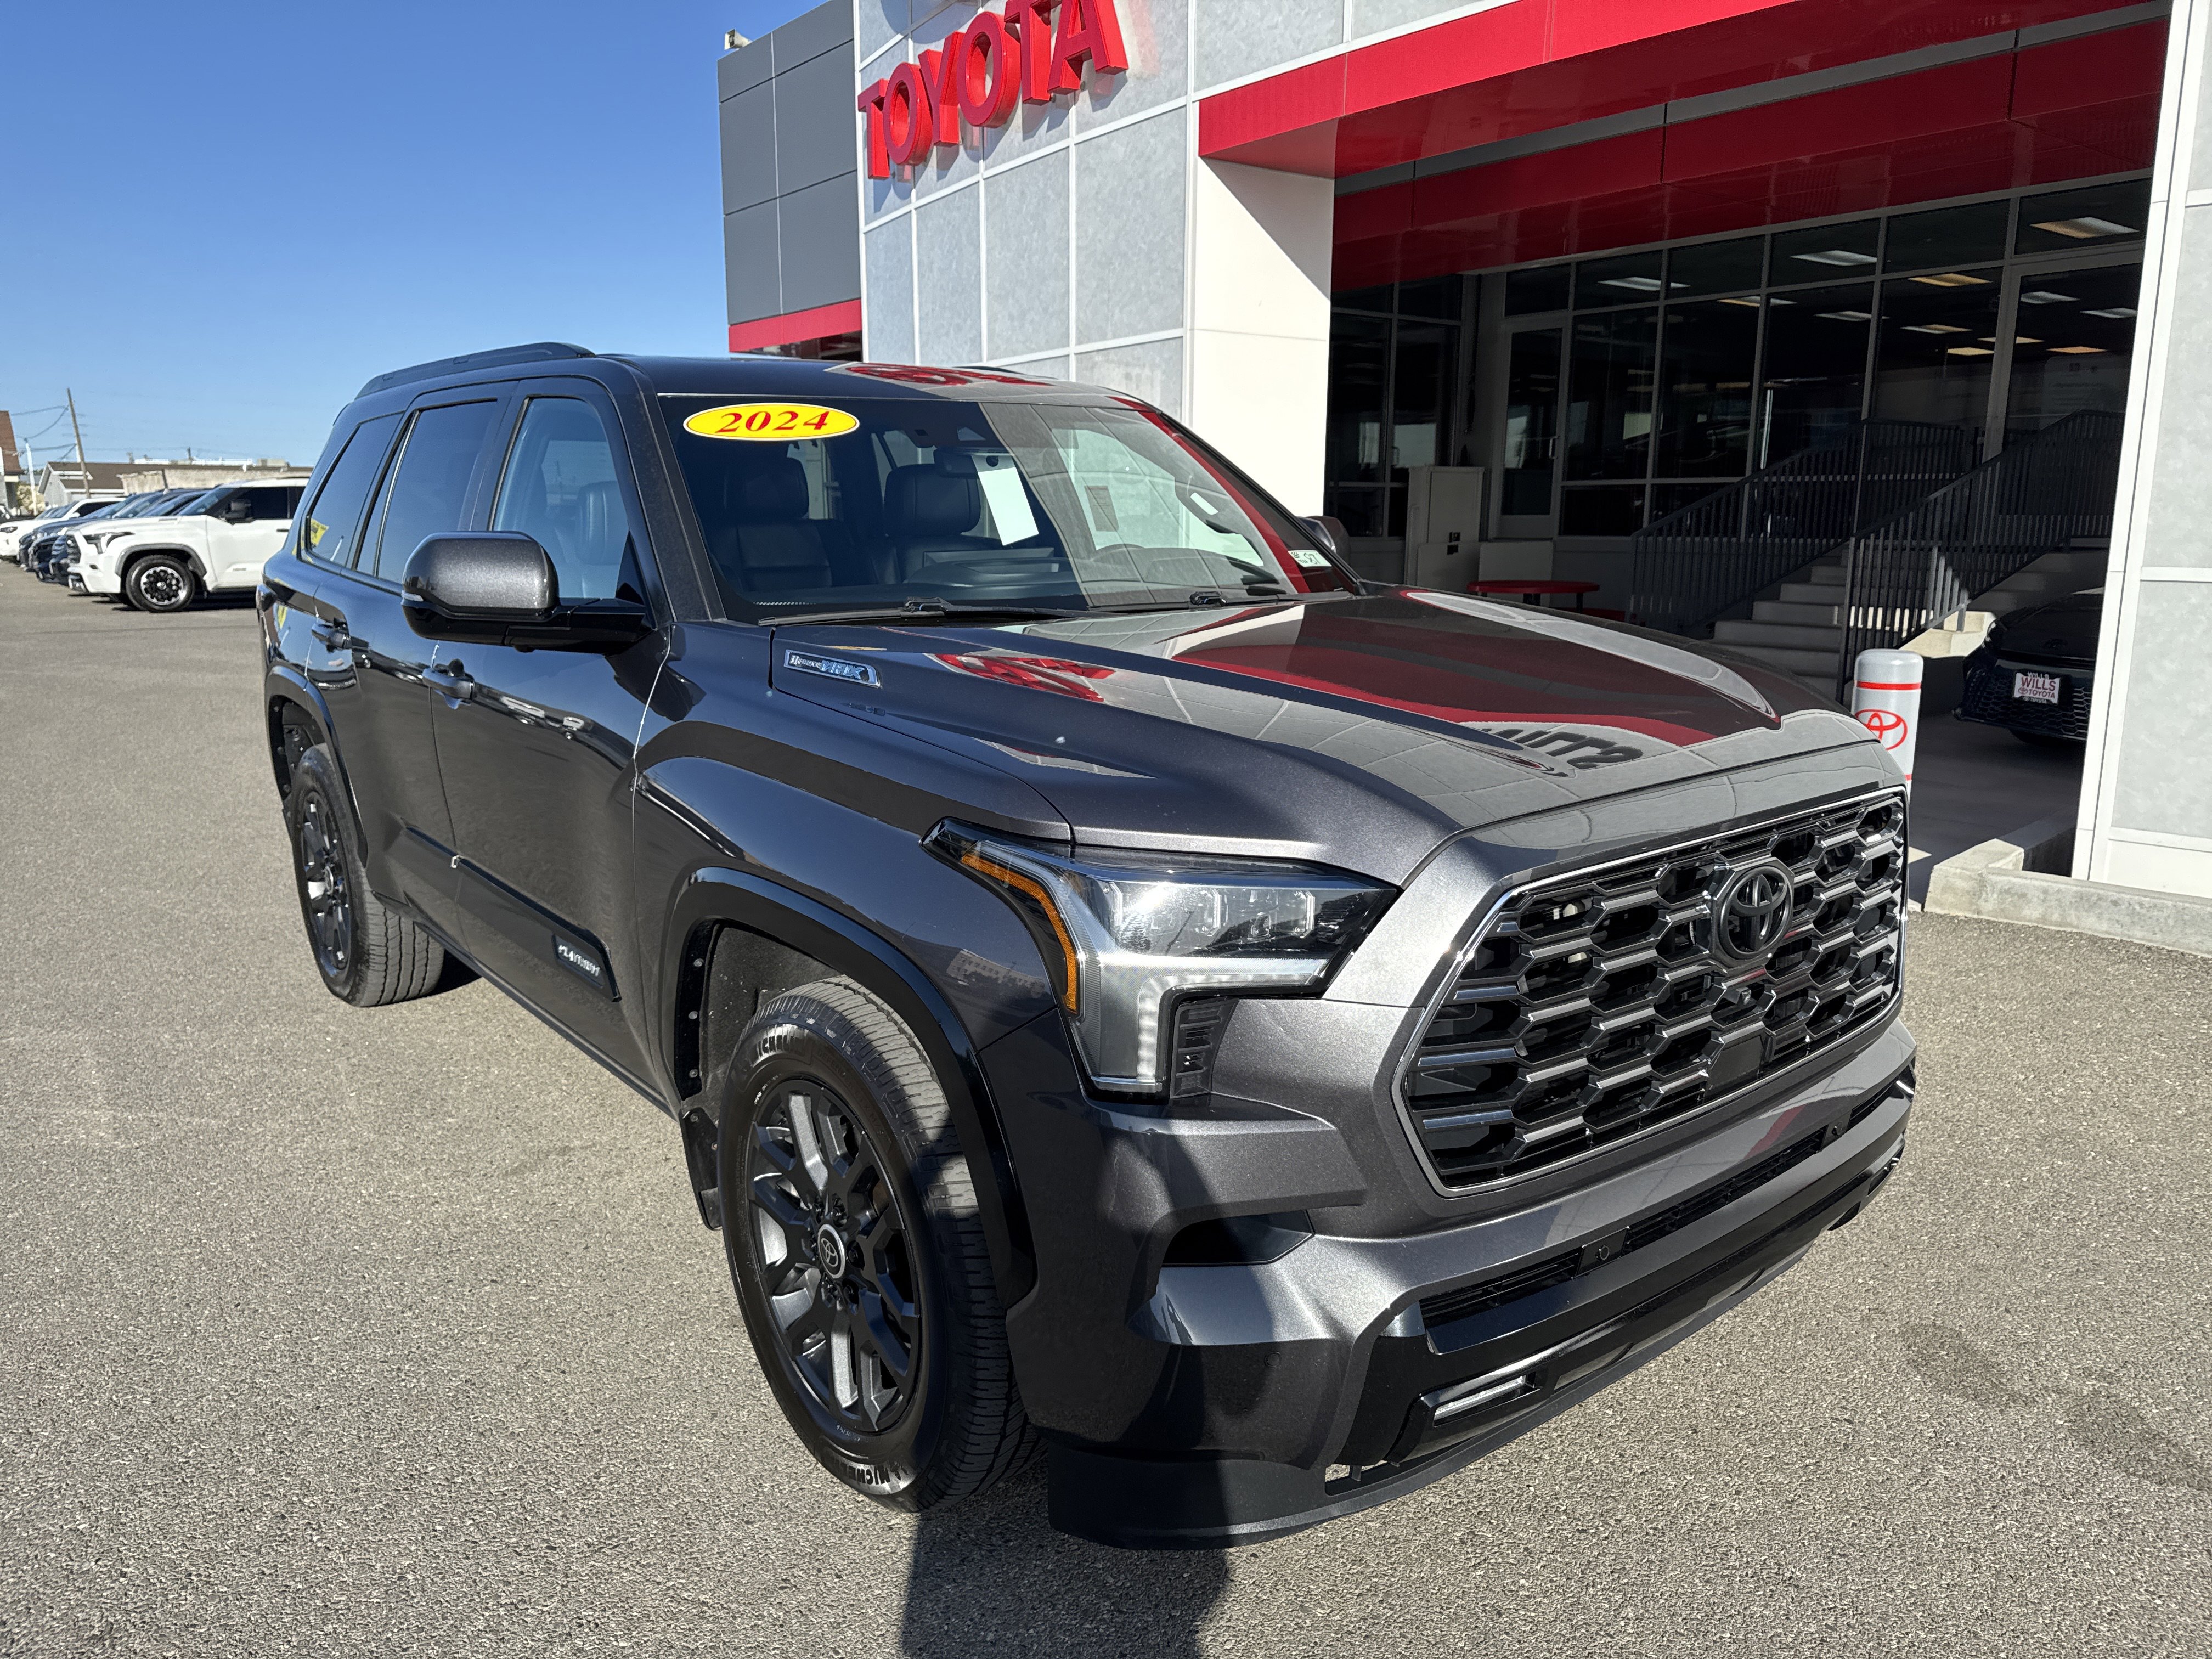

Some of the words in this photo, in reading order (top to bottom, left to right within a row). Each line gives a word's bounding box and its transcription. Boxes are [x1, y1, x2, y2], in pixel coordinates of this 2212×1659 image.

[857, 0, 1129, 179] TOYOTA
[715, 411, 830, 433] 2024
[820, 659, 865, 680] MAX
[2021, 676, 2056, 692] WILLS
[2029, 689, 2056, 699] TOYOTA
[558, 945, 601, 977] PLATINUM
